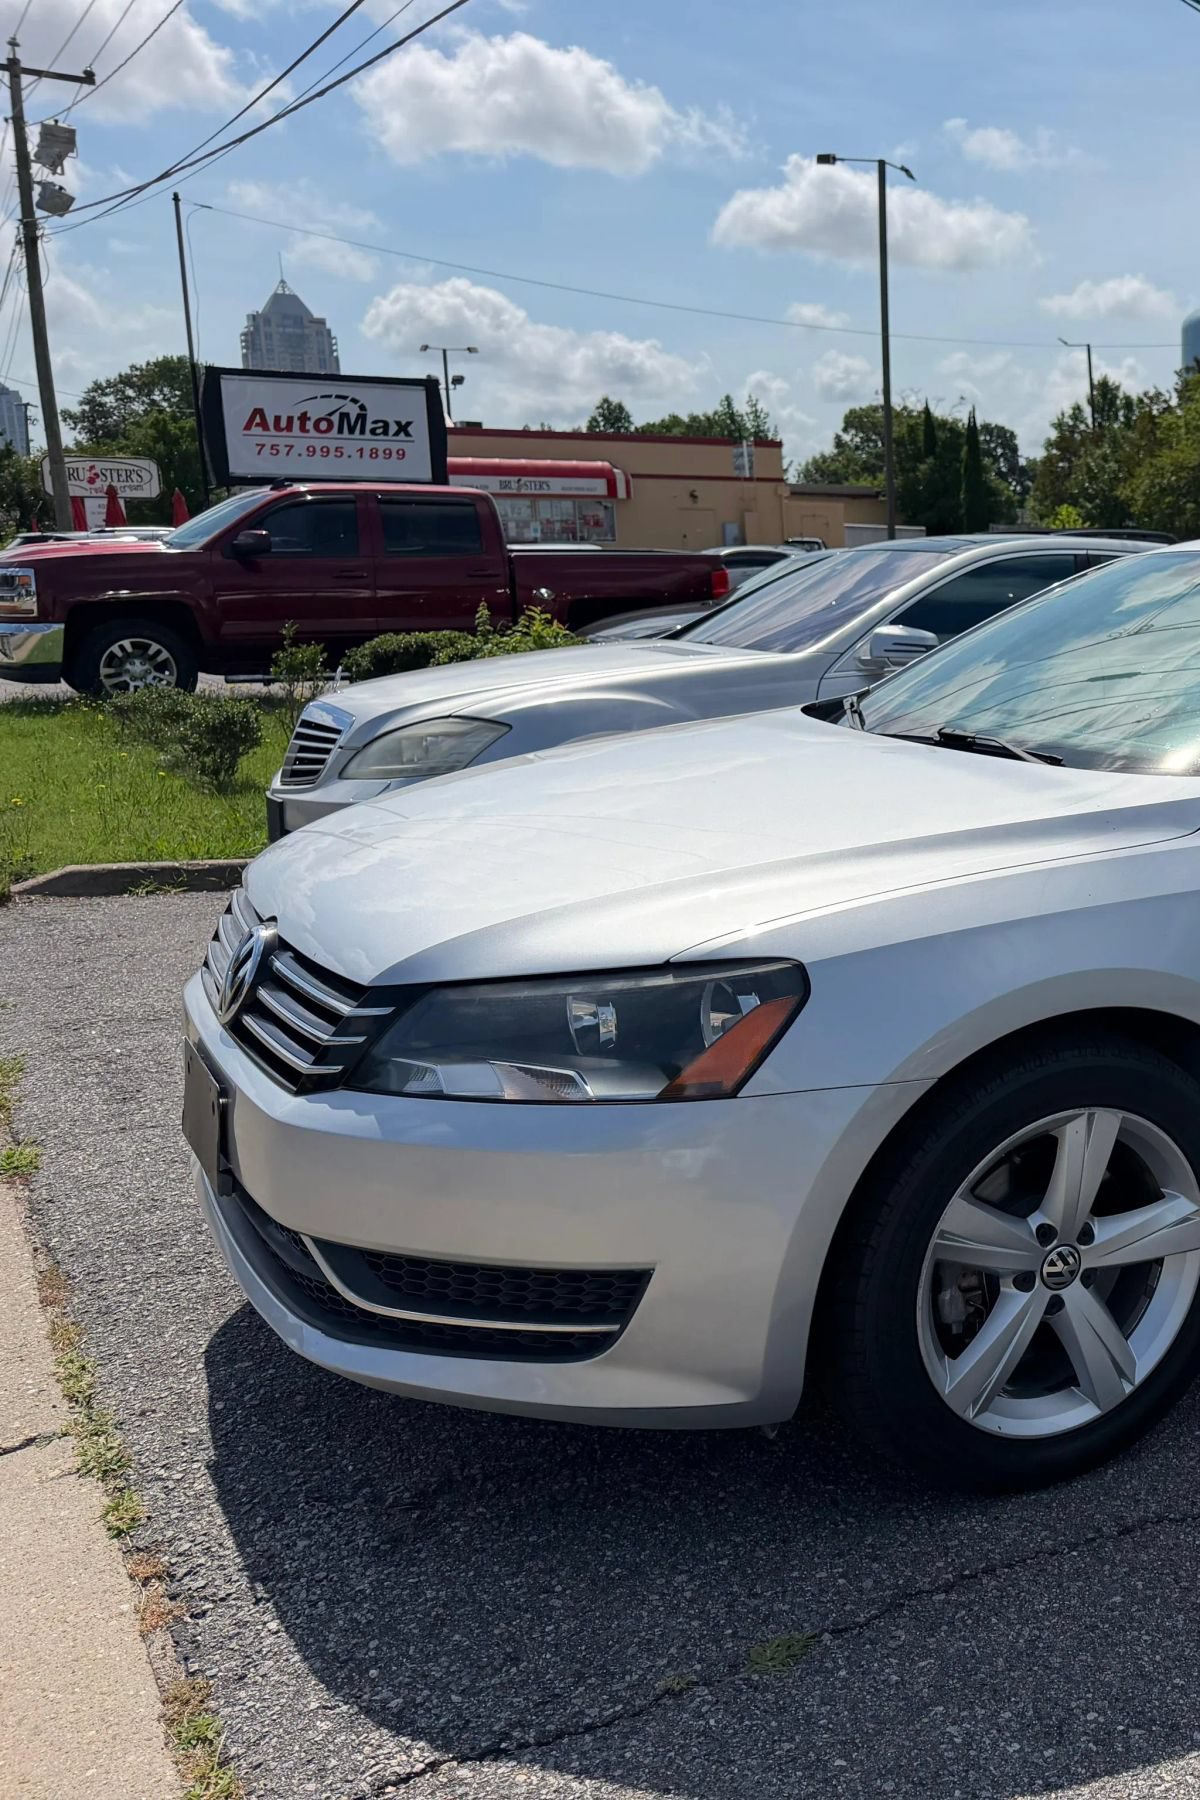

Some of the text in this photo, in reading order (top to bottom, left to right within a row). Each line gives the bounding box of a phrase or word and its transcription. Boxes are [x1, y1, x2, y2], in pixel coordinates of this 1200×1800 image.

[242, 407, 415, 438] AutoMax
[255, 443, 406, 460] 757.995.1899
[66, 467, 144, 483] RUSTER'S
